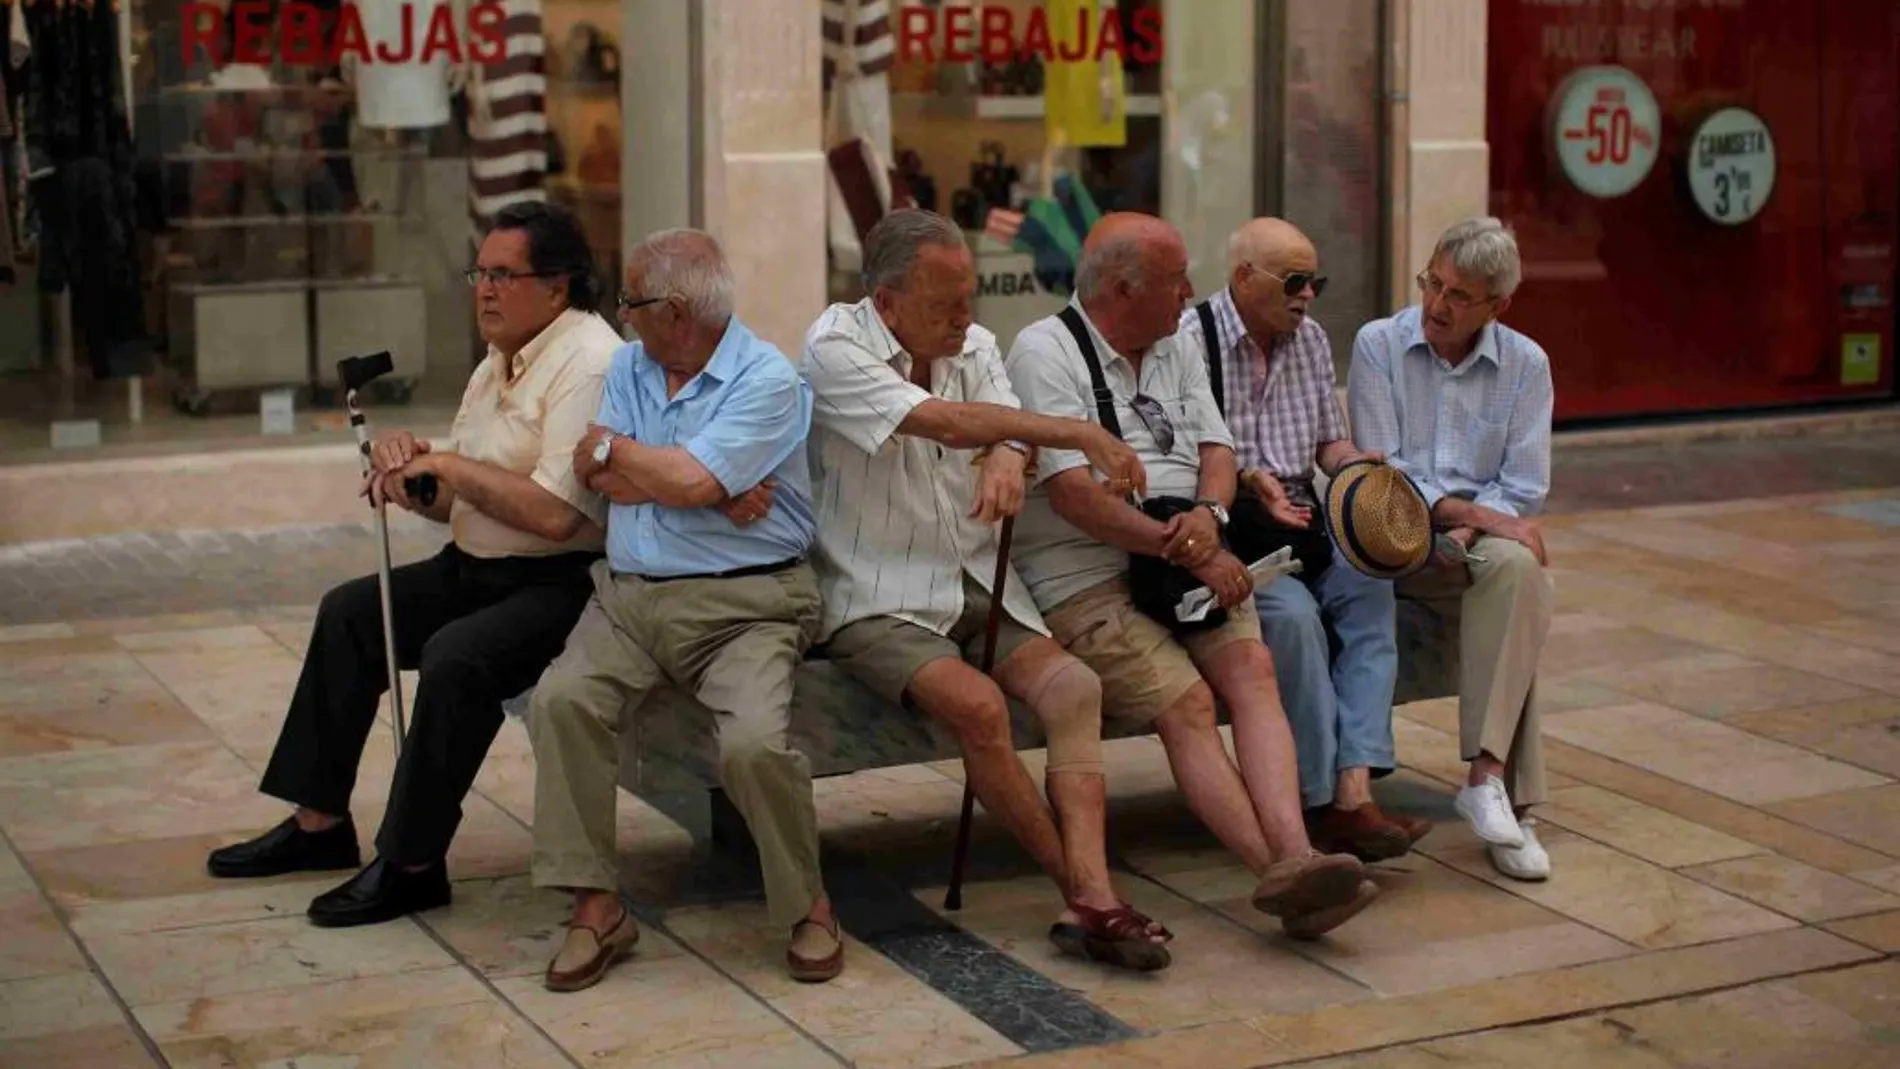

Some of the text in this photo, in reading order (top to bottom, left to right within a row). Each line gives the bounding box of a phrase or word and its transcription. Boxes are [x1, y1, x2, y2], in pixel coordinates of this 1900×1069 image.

[179, 0, 507, 66] REBAJAS
[898, 6, 1164, 64] REBAJAS
[975, 271, 1036, 296] MBA
